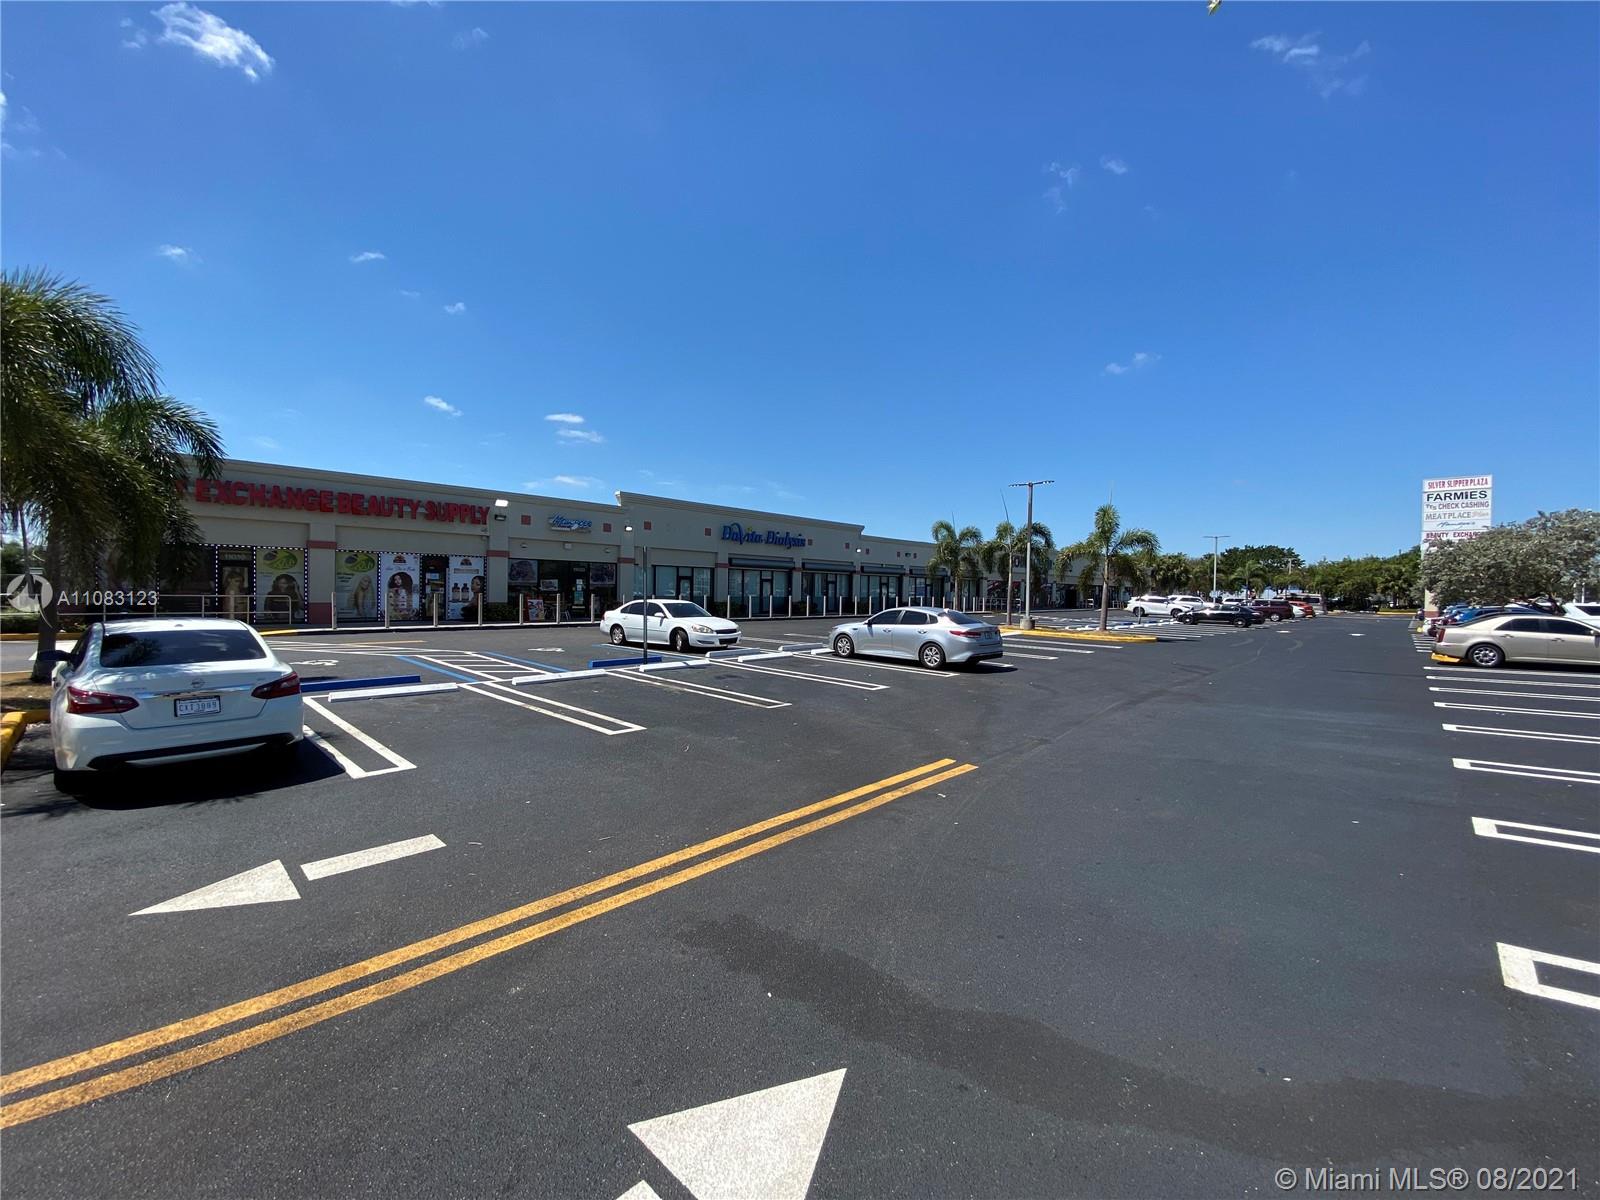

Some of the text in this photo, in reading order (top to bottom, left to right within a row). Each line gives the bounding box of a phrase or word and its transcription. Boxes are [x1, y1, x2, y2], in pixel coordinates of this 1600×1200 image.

[1428, 478, 1488, 489] SILVER SLIPPER PLAZA
[1426, 490, 1488, 501] FARMIES
[195, 479, 334, 512] EXCHANGE
[337, 491, 420, 519] BEAUTY
[424, 500, 490, 526] SUPPLY
[1460, 501, 1489, 509] CASHING
[765, 531, 806, 549] Dialysis
